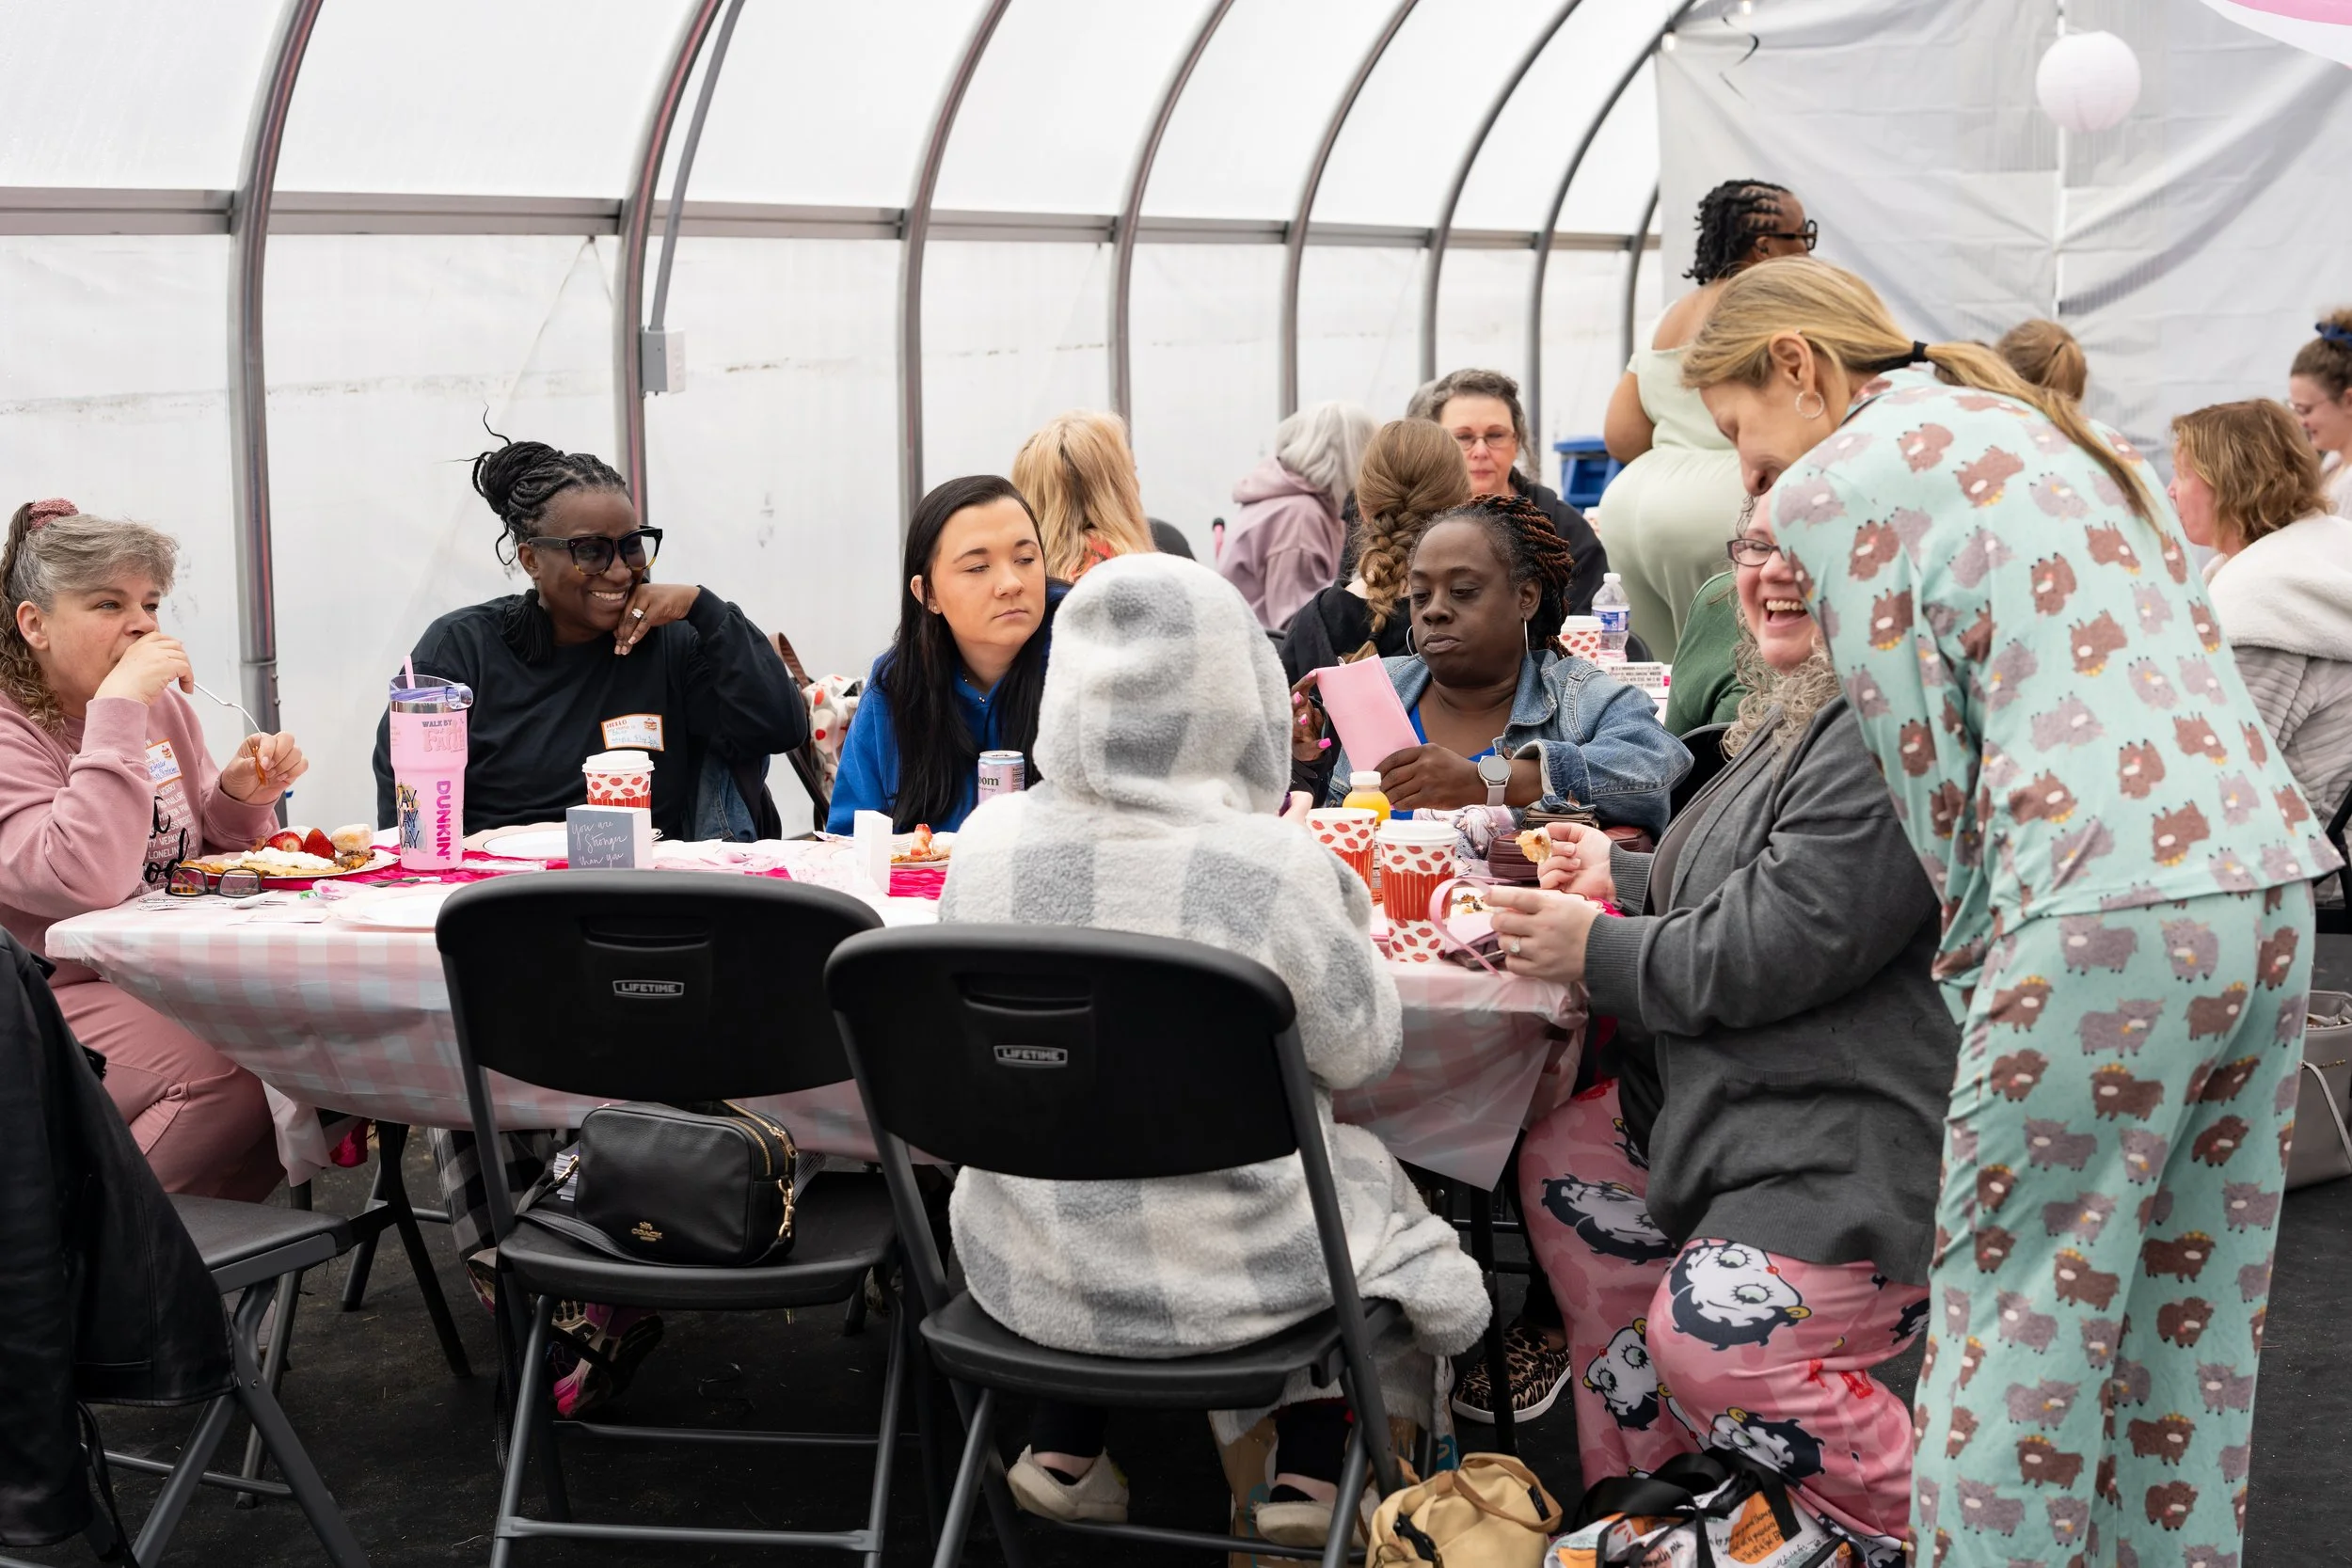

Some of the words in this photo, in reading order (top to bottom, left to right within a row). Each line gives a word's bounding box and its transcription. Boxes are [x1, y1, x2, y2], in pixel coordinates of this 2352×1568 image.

[421, 720, 442, 728] WALK
[443, 719, 453, 727] BY
[436, 780, 452, 861] DUNKIN'
[597, 821, 614, 830] are
[579, 855, 604, 866] than
[606, 853, 624, 868] you
[621, 983, 676, 993] LIFETIME
[1002, 1049, 1059, 1061] LIFETIME
[631, 1227, 663, 1240] COACH
